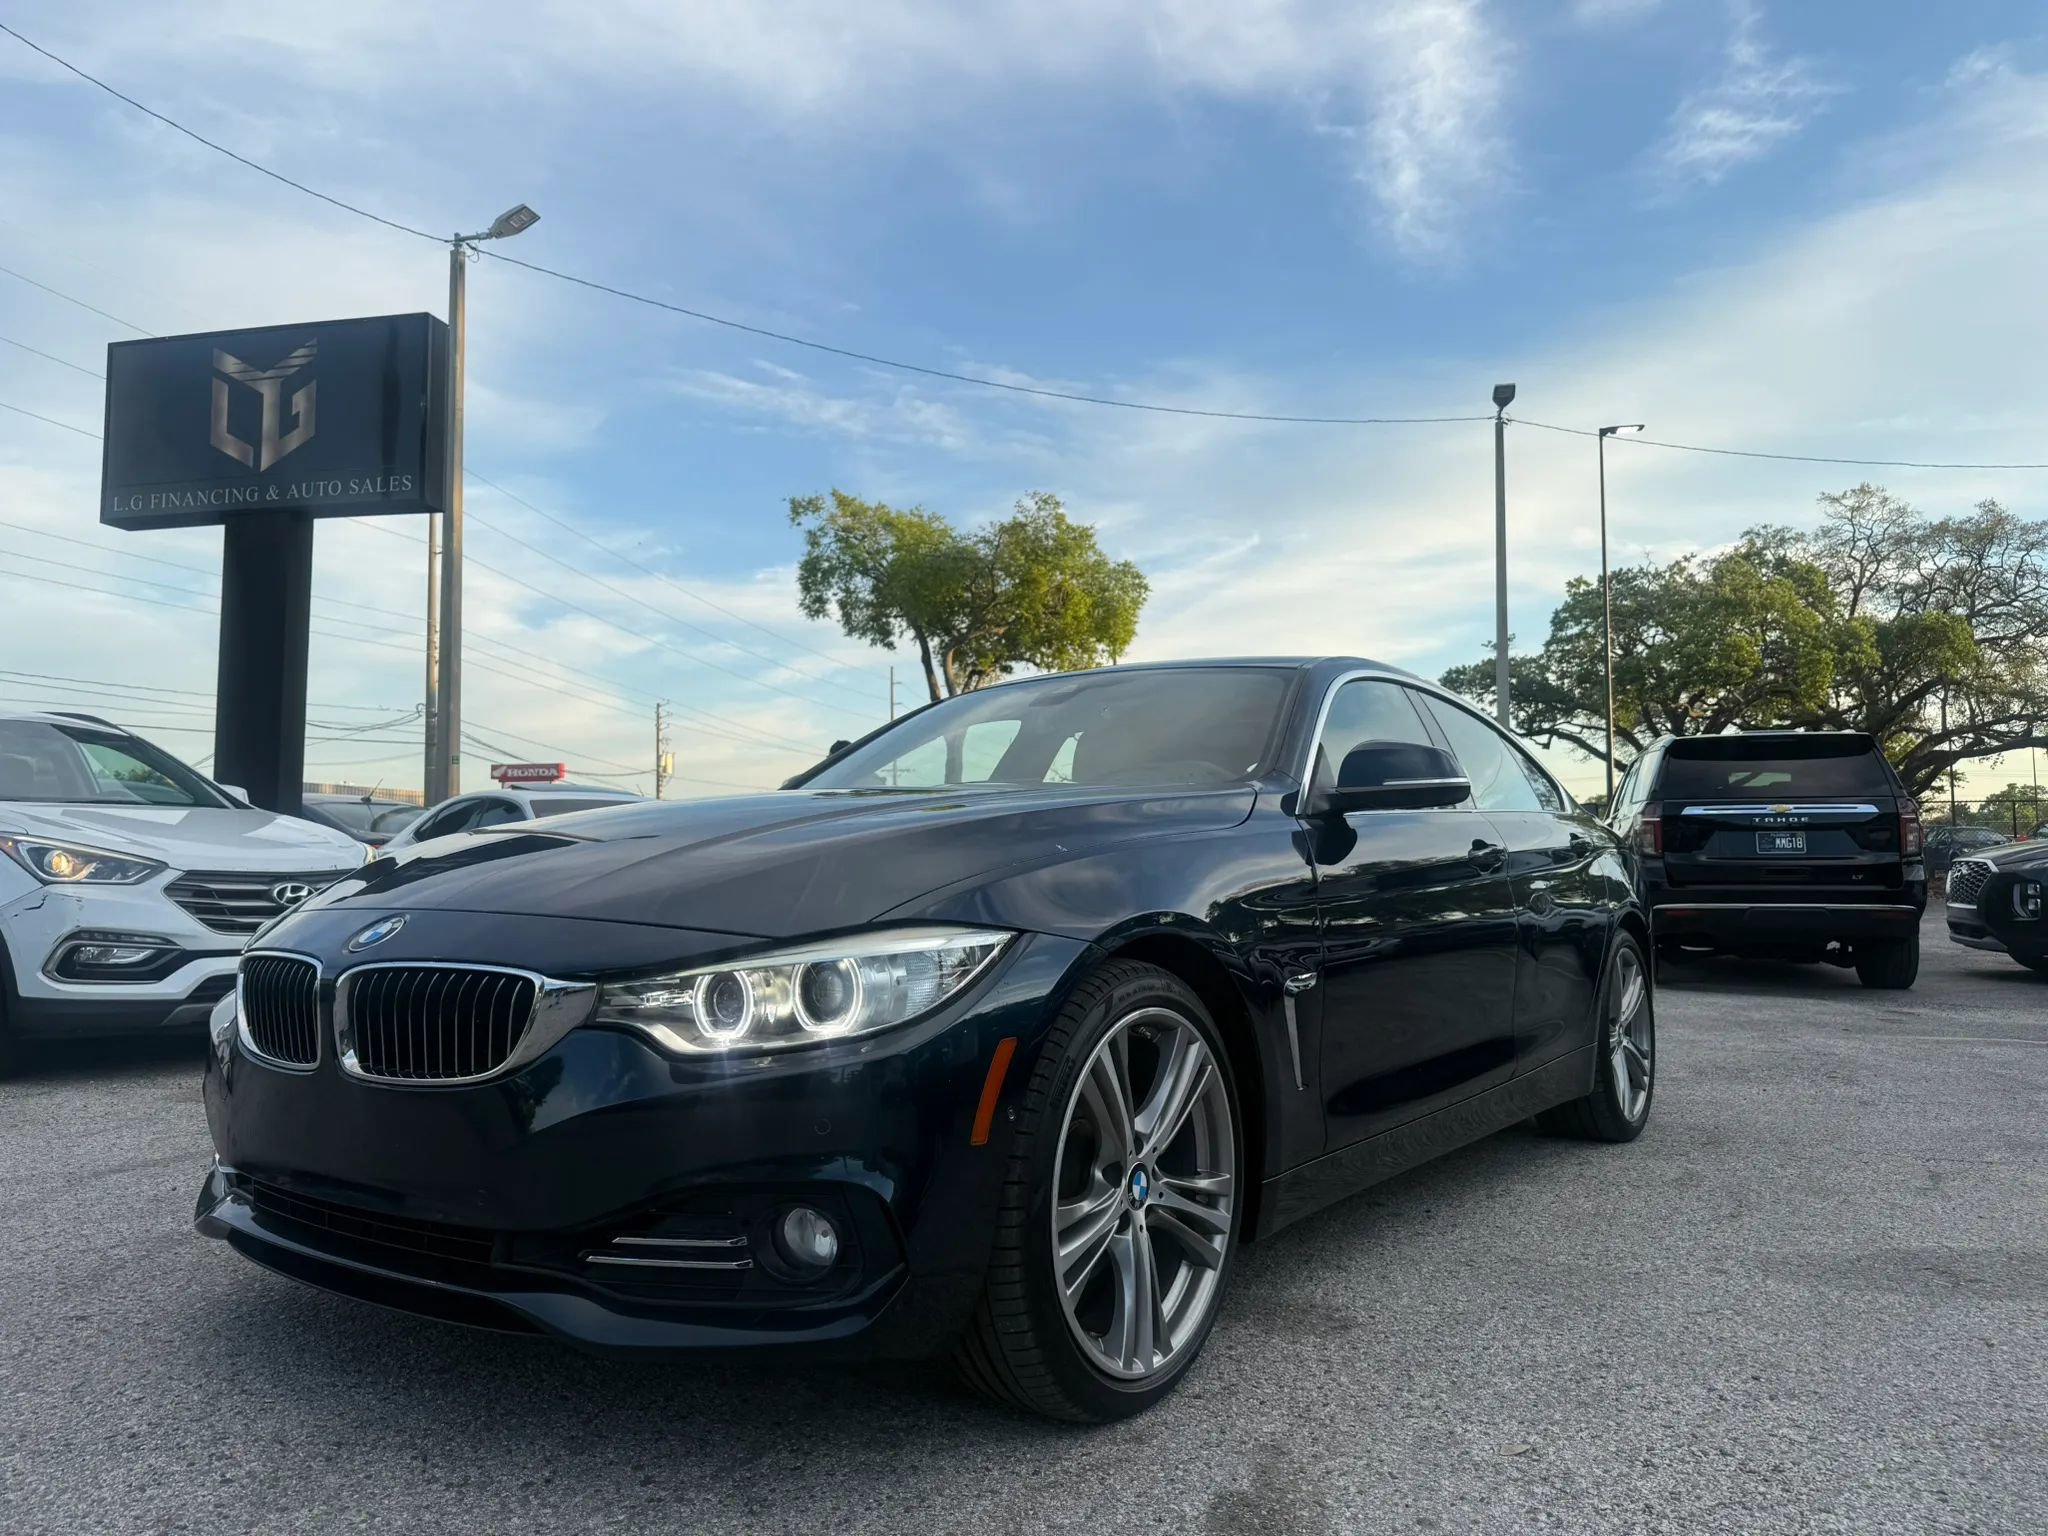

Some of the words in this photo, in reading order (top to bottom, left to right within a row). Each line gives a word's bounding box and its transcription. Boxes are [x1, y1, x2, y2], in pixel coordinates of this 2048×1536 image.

[113, 495, 143, 512] L.G
[151, 486, 259, 509] FINANCING
[266, 484, 279, 500] &
[286, 480, 342, 498] AUTO
[349, 475, 413, 494] SALES
[506, 767, 558, 777] HONDA
